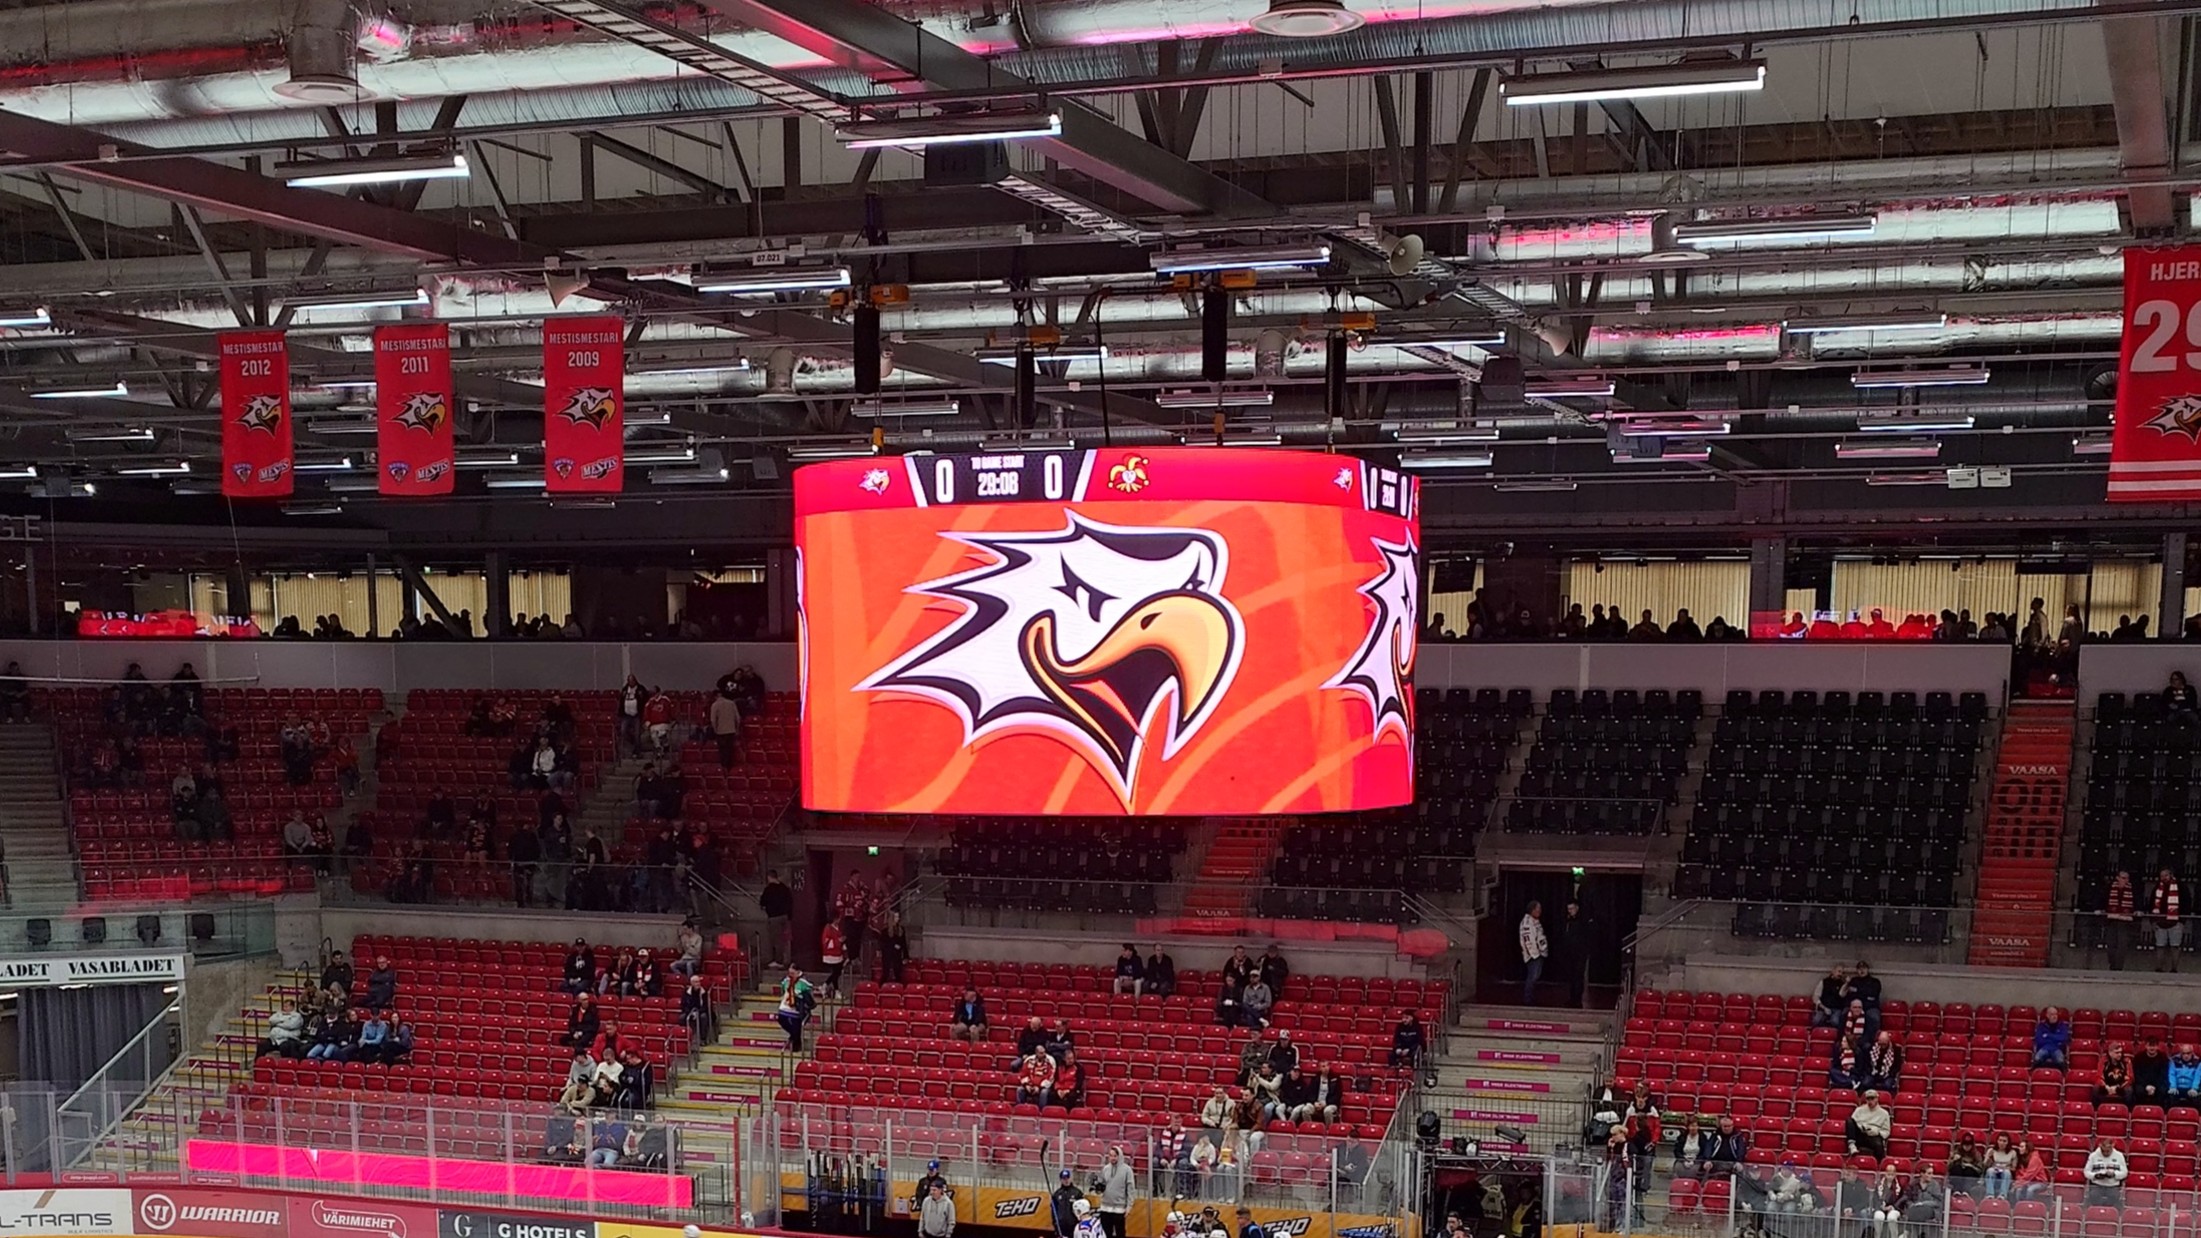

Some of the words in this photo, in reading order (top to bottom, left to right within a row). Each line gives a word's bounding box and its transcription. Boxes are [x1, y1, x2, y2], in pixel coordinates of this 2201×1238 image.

[549, 332, 618, 344] MESTISMESTARI
[241, 359, 271, 376] 2012
[401, 356, 429, 374] 2011
[568, 351, 600, 367] 2009
[935, 459, 954, 503] 0
[977, 471, 1019, 496] 29:08
[1044, 455, 1063, 499] 0
[2009, 765, 2057, 775] VAASA
[1989, 938, 2030, 947] VAASA
[0, 963, 49, 977] ADET
[68, 958, 175, 975] VASABLADET
[180, 1206, 281, 1225] WARRIOR
[996, 1199, 1039, 1217] TEHO
[322, 1210, 396, 1229] VÄRIMIEHET
[498, 1223, 511, 1238] G
[515, 1224, 586, 1238] HOTELS
